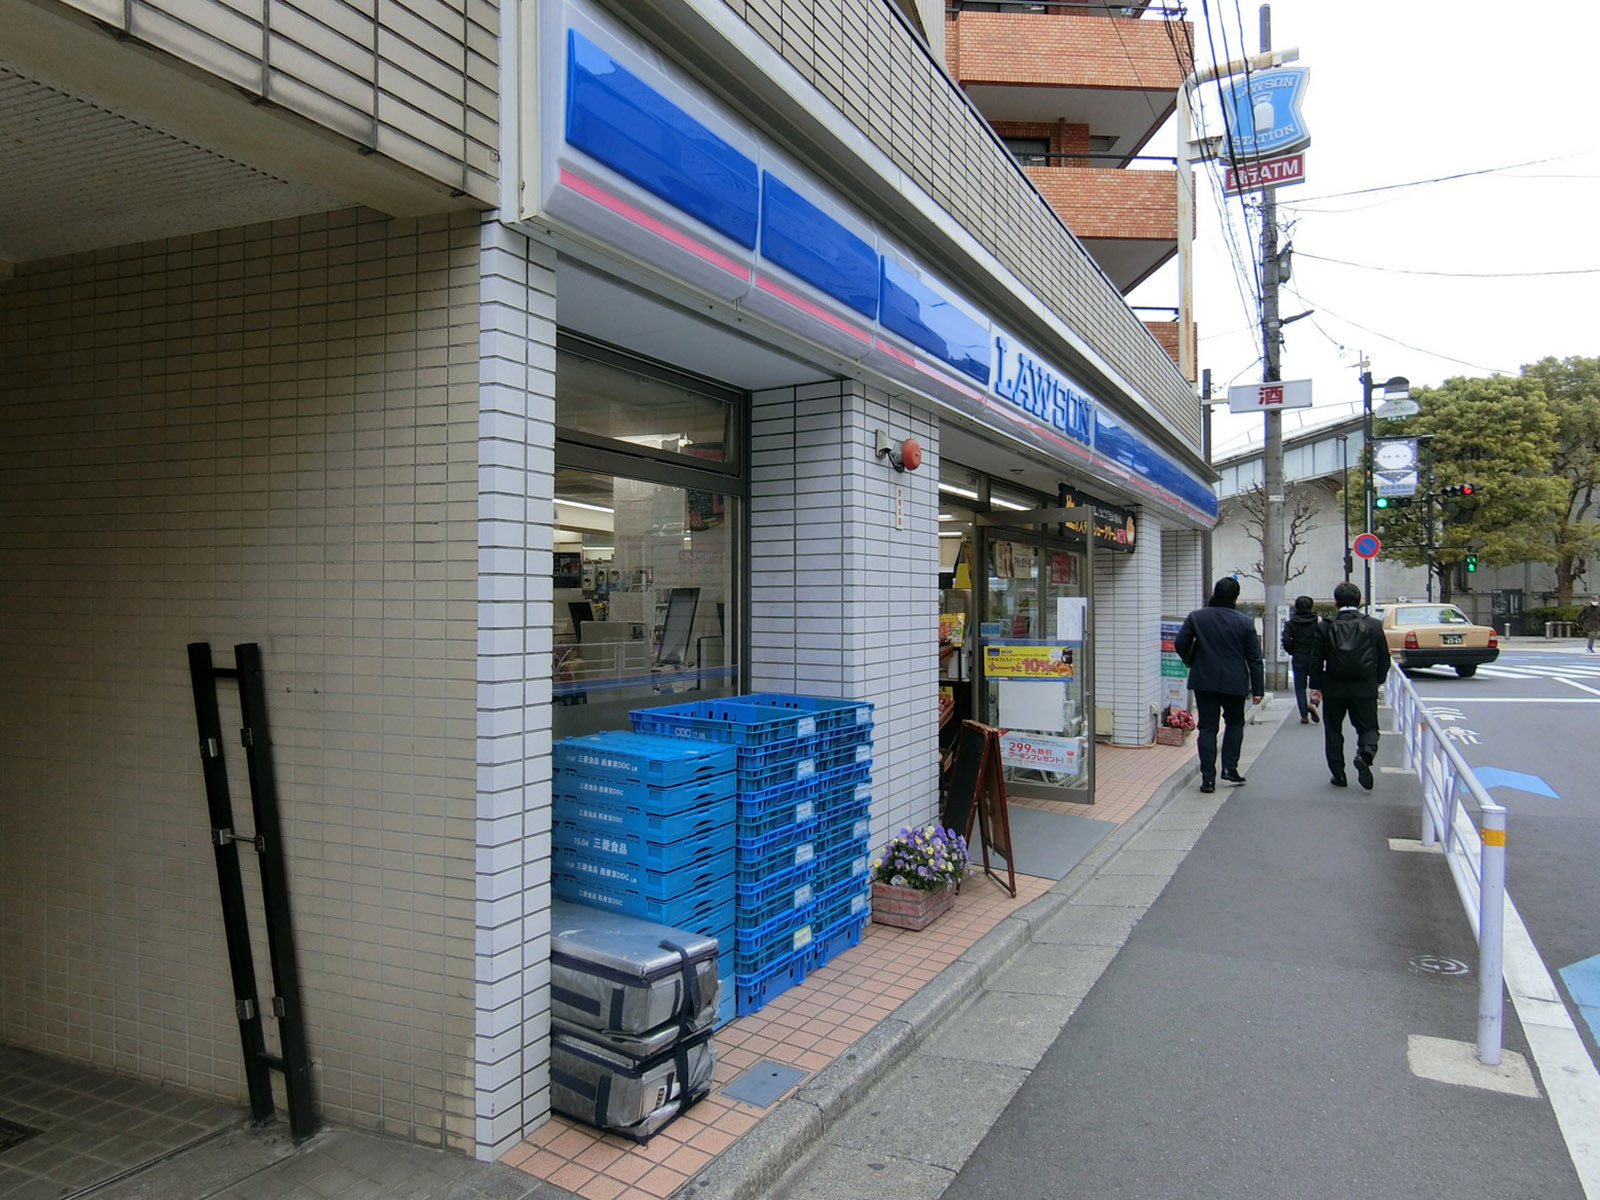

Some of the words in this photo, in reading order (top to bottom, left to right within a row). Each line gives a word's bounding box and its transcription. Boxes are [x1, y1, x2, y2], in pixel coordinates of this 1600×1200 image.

[1232, 124, 1295, 146] STATION
[1230, 158, 1299, 187] 銀行ATM
[994, 336, 1092, 445] LAWSON
[1258, 385, 1284, 405] 酒
[593, 838, 627, 855] 三菱食品
